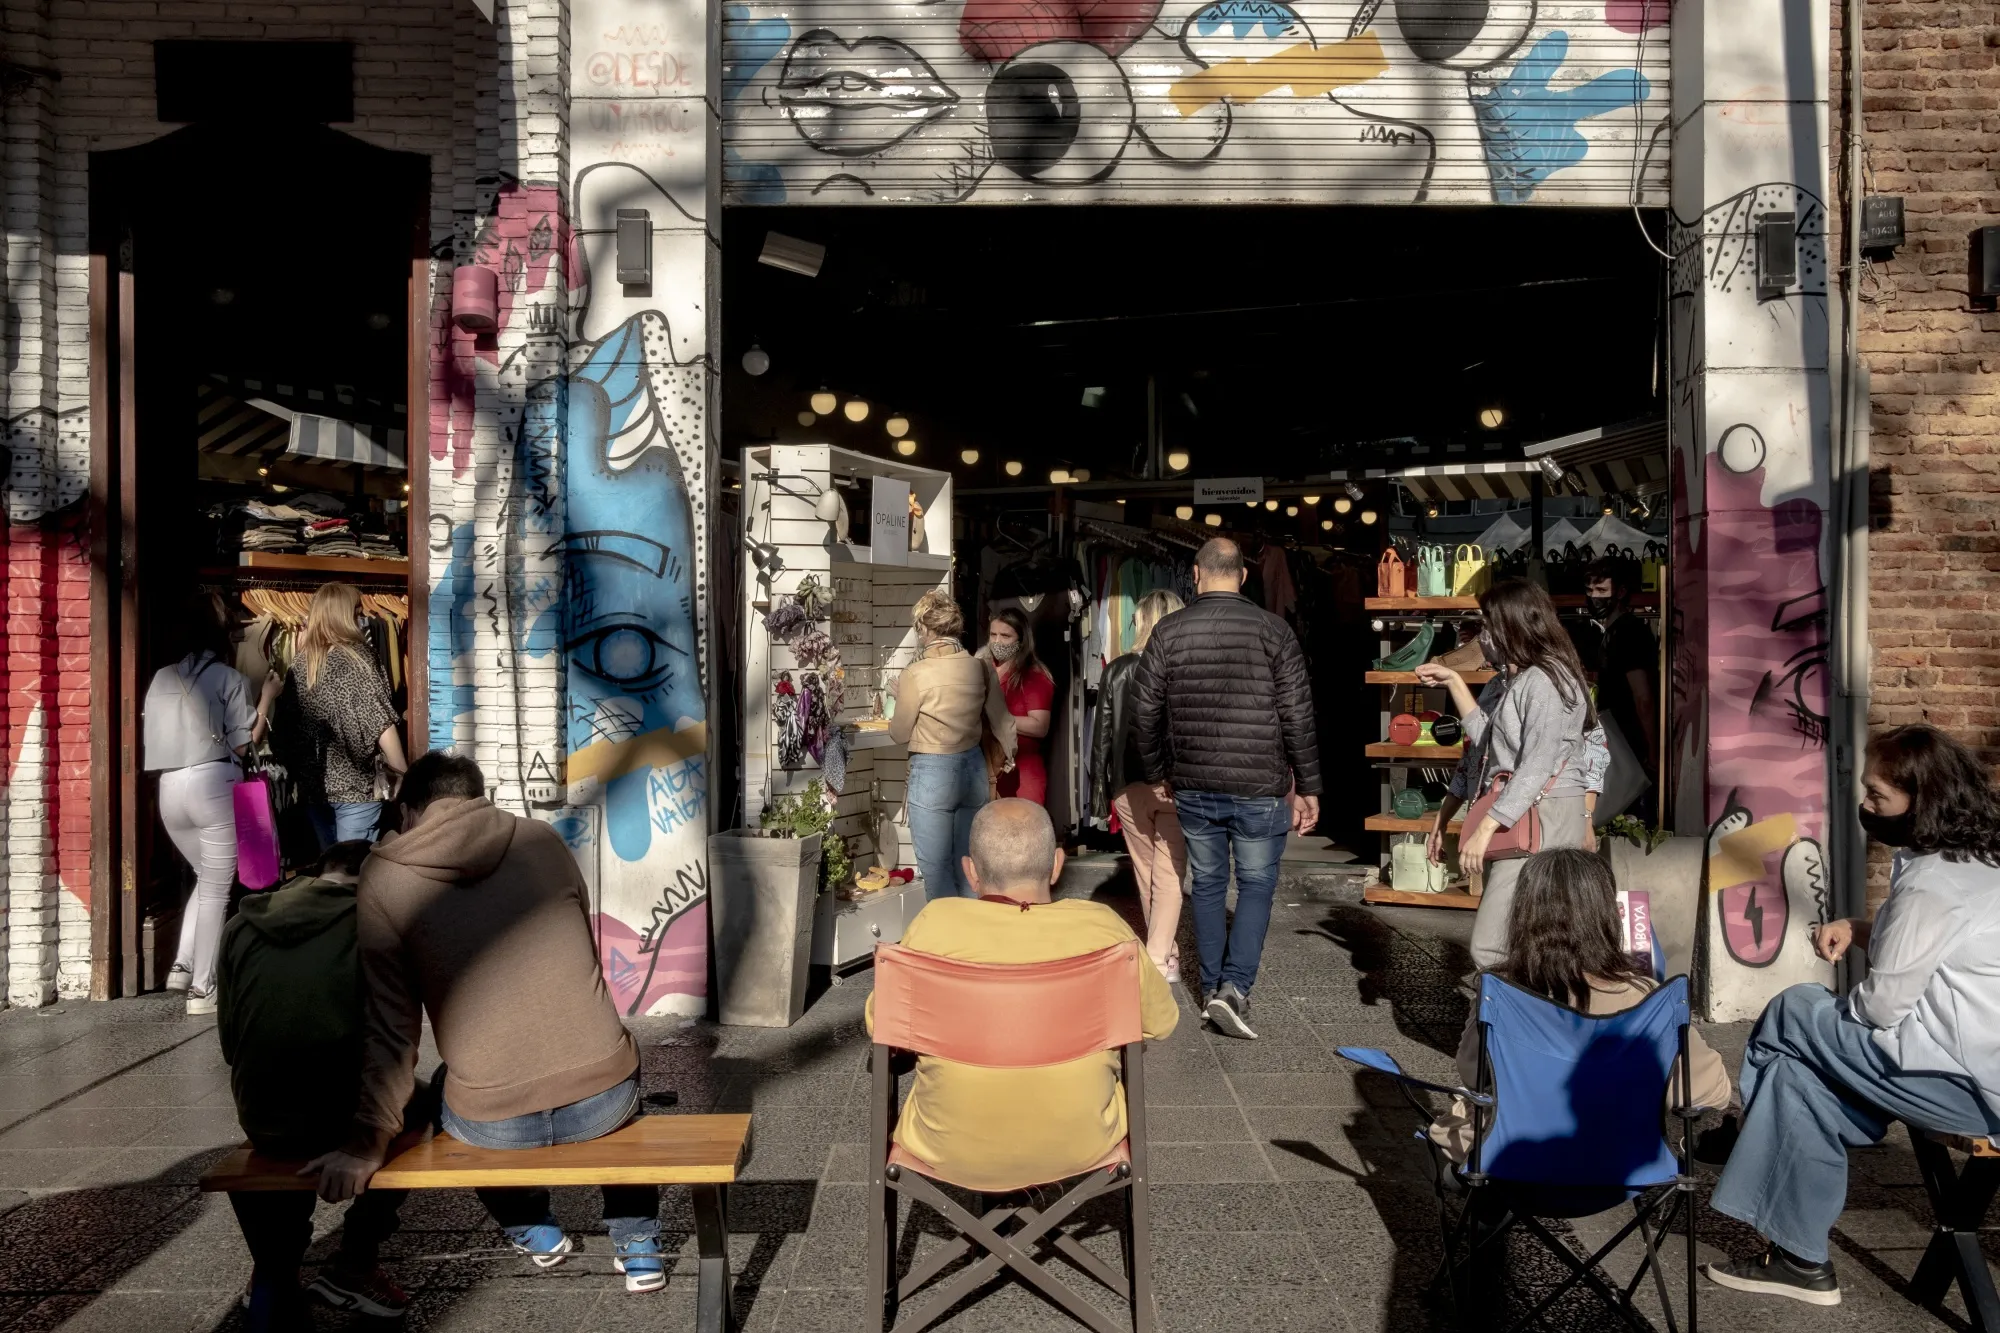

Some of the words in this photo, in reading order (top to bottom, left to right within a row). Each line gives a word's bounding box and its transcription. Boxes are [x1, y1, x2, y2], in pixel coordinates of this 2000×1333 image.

[1201, 486, 1256, 496] bienvenidos
[875, 512, 906, 528] OPALINE
[1633, 904, 1649, 970] AMBOYA
